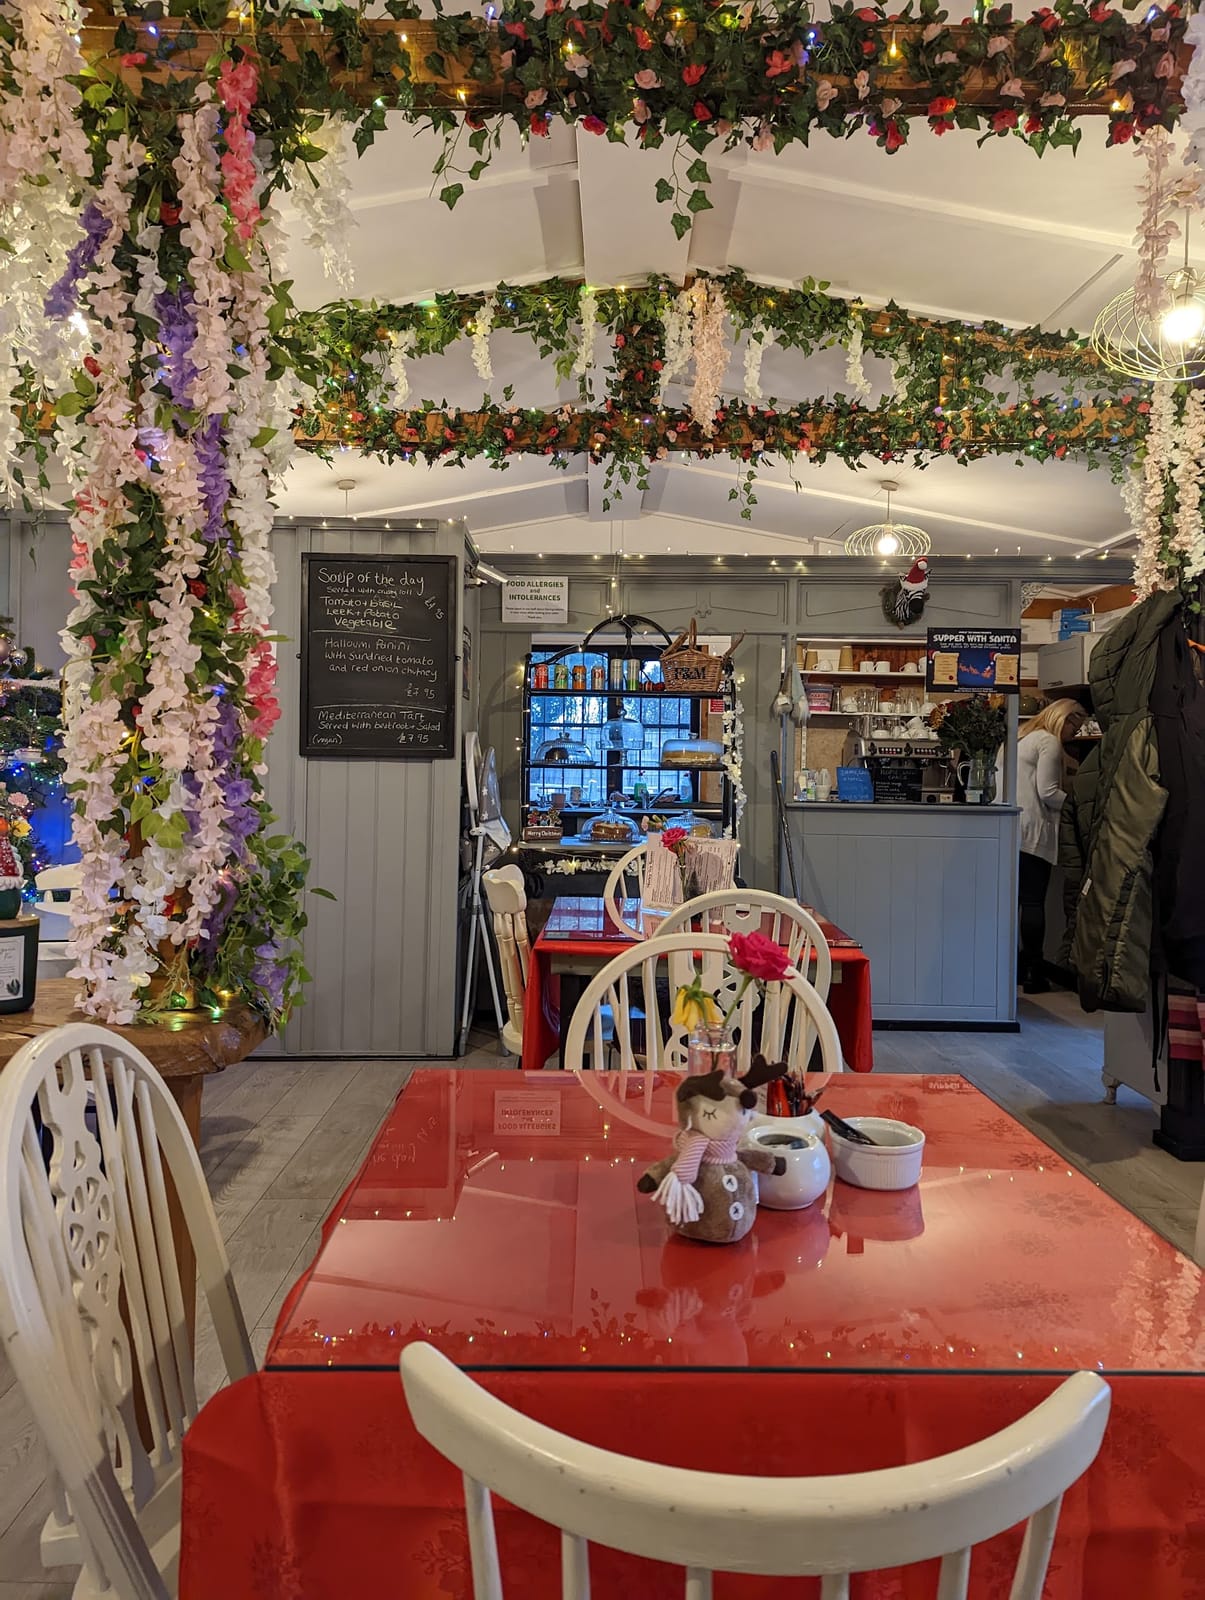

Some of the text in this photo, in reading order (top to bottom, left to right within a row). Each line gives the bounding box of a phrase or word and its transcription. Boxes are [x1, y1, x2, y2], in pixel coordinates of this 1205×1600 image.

[318, 568, 424, 596] Soup of the day
[335, 617, 397, 630] Vegetable
[324, 637, 410, 651] Halloumi Panini
[933, 634, 965, 642] SUPPER
[989, 635, 1017, 643] SANTA
[396, 655, 434, 666] tomato
[329, 664, 438, 682] and red onion chutney
[318, 710, 424, 722] Mediterranean Tart
[318, 721, 349, 730] Served
[352, 721, 372, 729] with
